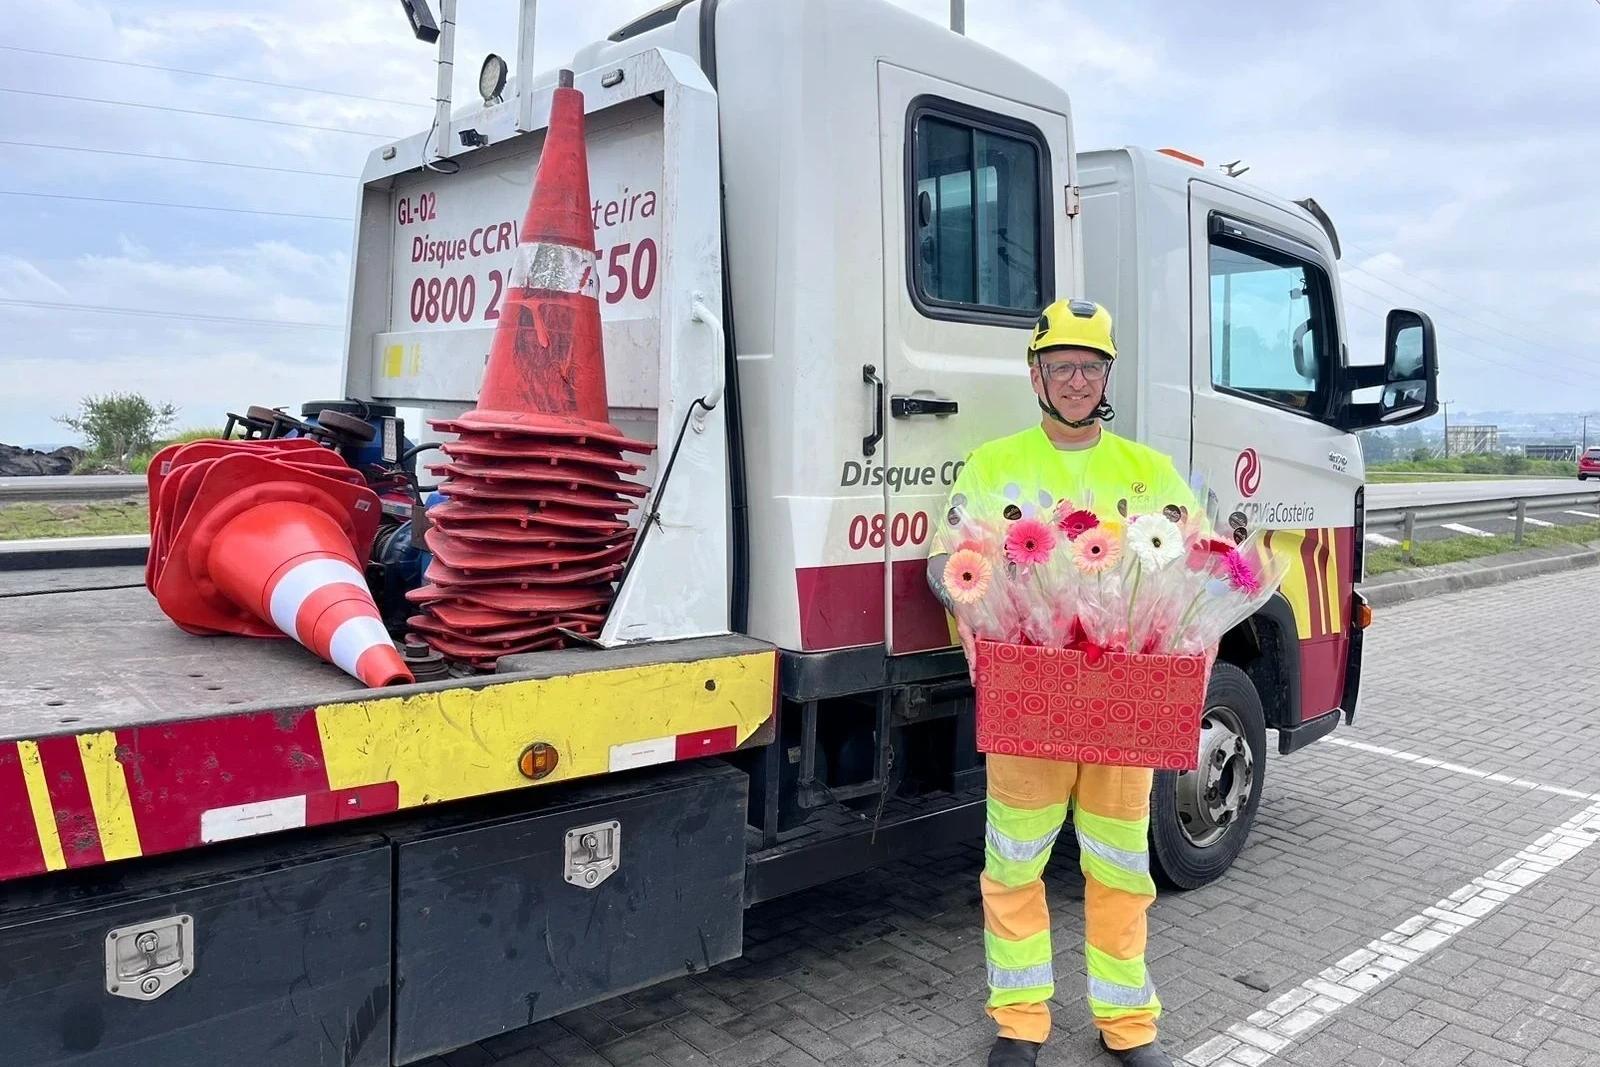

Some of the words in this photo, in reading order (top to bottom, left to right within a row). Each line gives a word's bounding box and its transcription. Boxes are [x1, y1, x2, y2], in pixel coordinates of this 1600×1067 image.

[398, 192, 436, 225] GL-02
[411, 234, 467, 269] Disque
[410, 274, 476, 324] 0800
[841, 460, 936, 492] Disque
[848, 511, 929, 550] 0800
